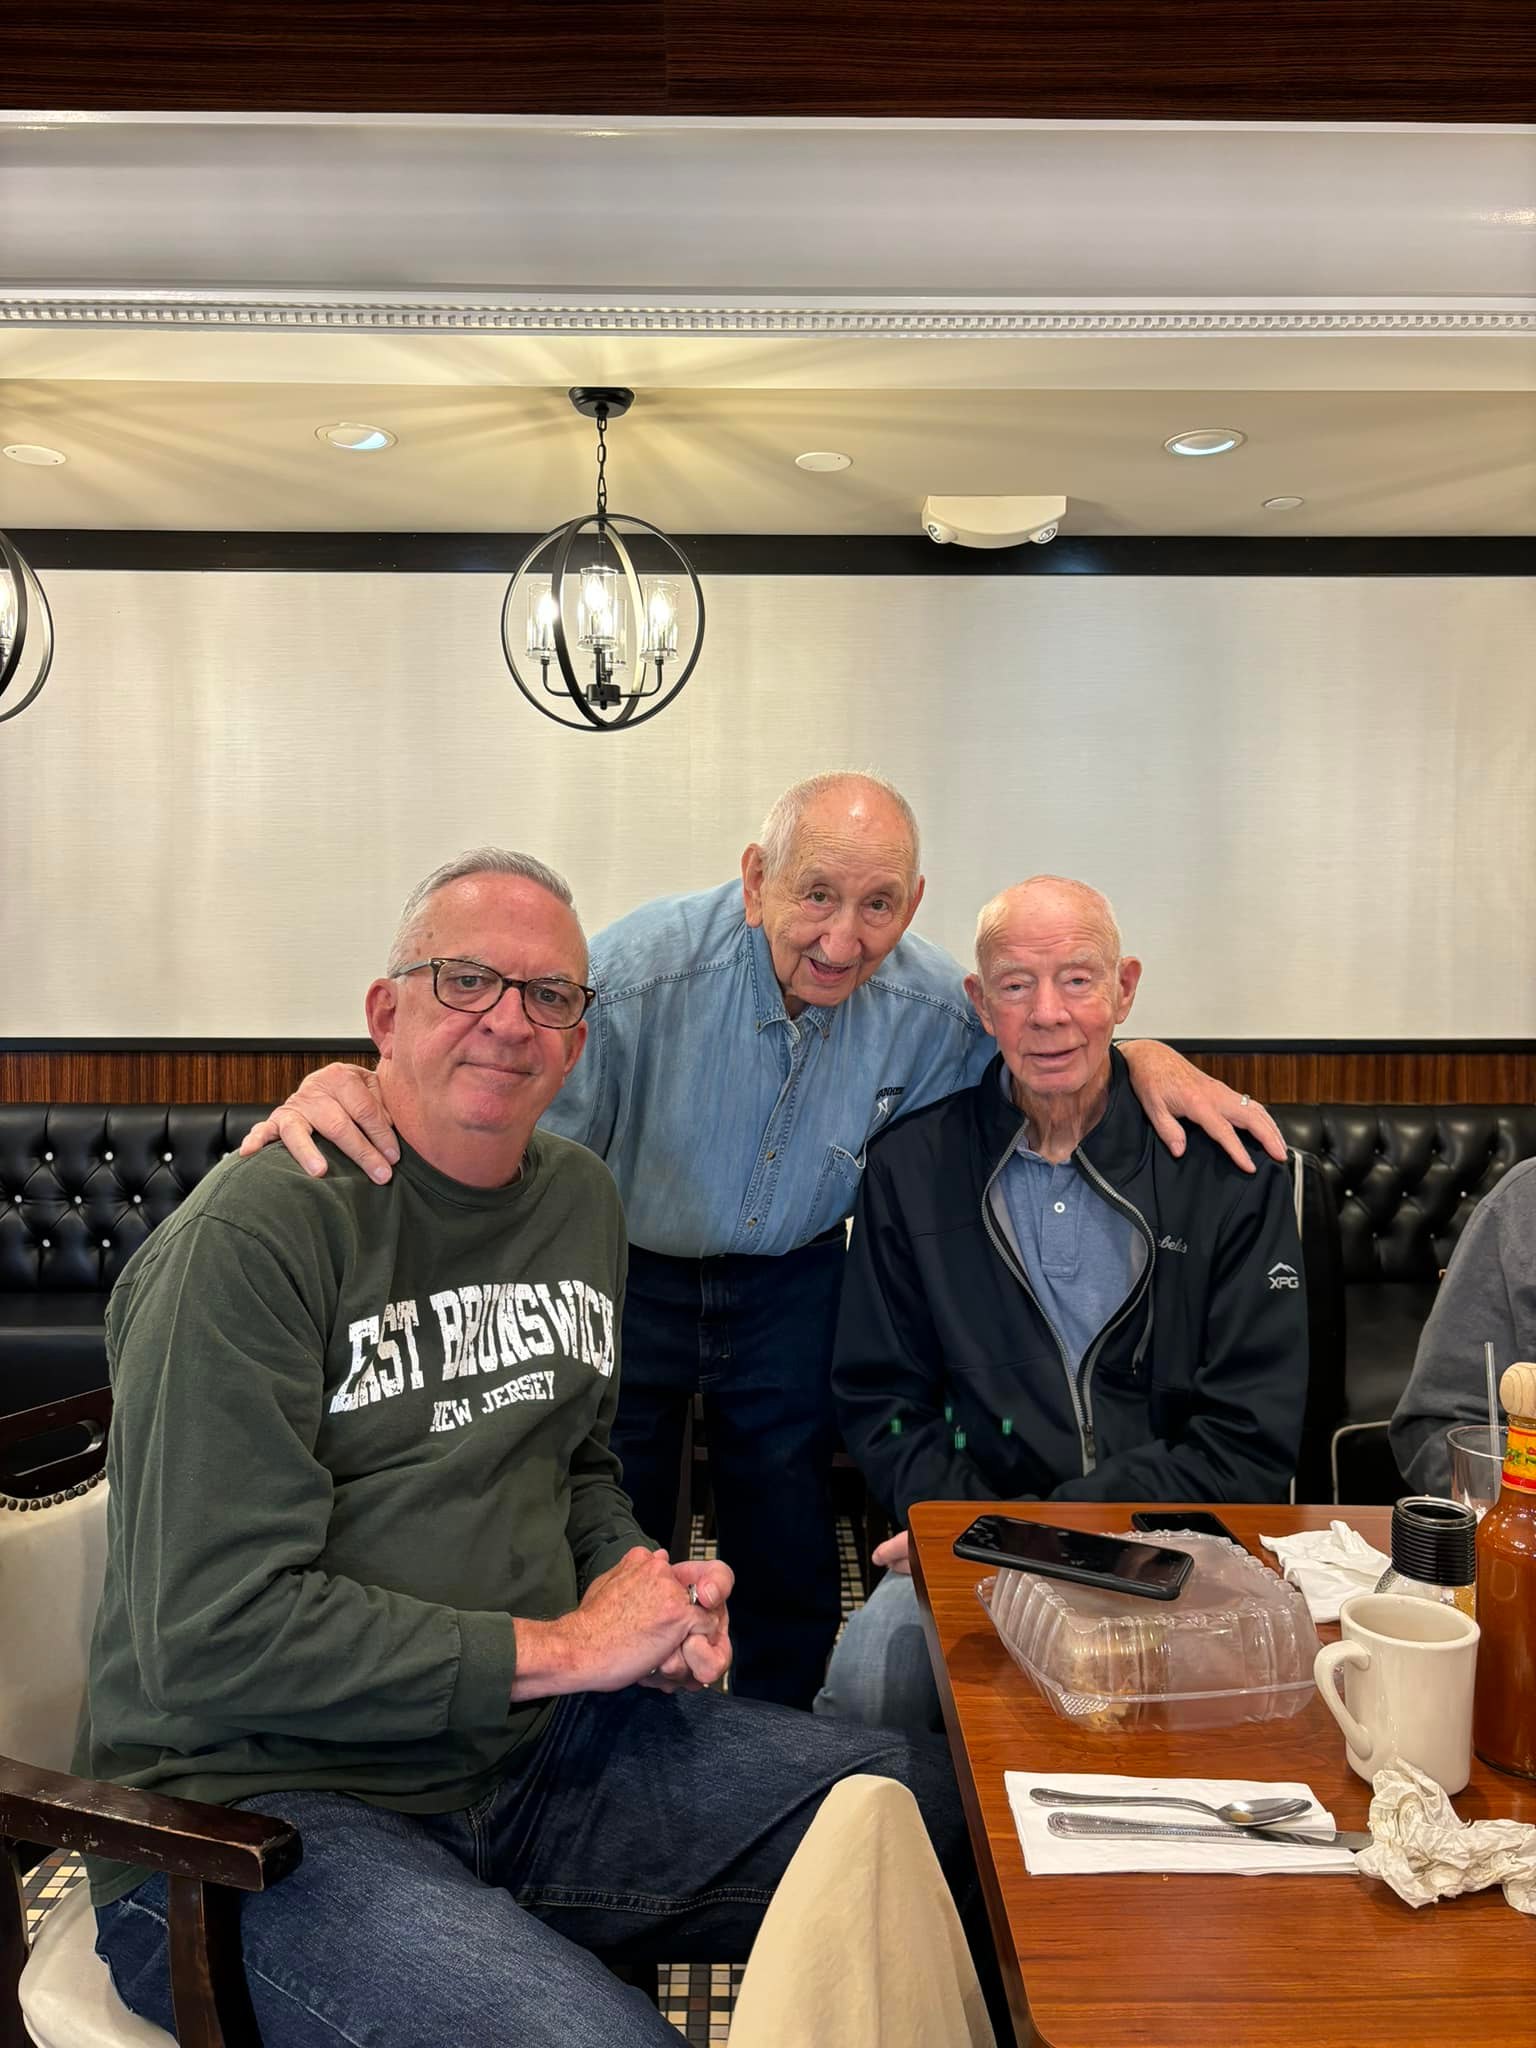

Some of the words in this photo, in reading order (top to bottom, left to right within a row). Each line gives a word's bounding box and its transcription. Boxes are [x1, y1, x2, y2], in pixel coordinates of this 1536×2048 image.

[1267, 1276, 1300, 1290] XPG
[429, 1280, 614, 1380] BRUNSWICK
[429, 1397, 473, 1433] NEW
[481, 1370, 555, 1414] JERSEY
